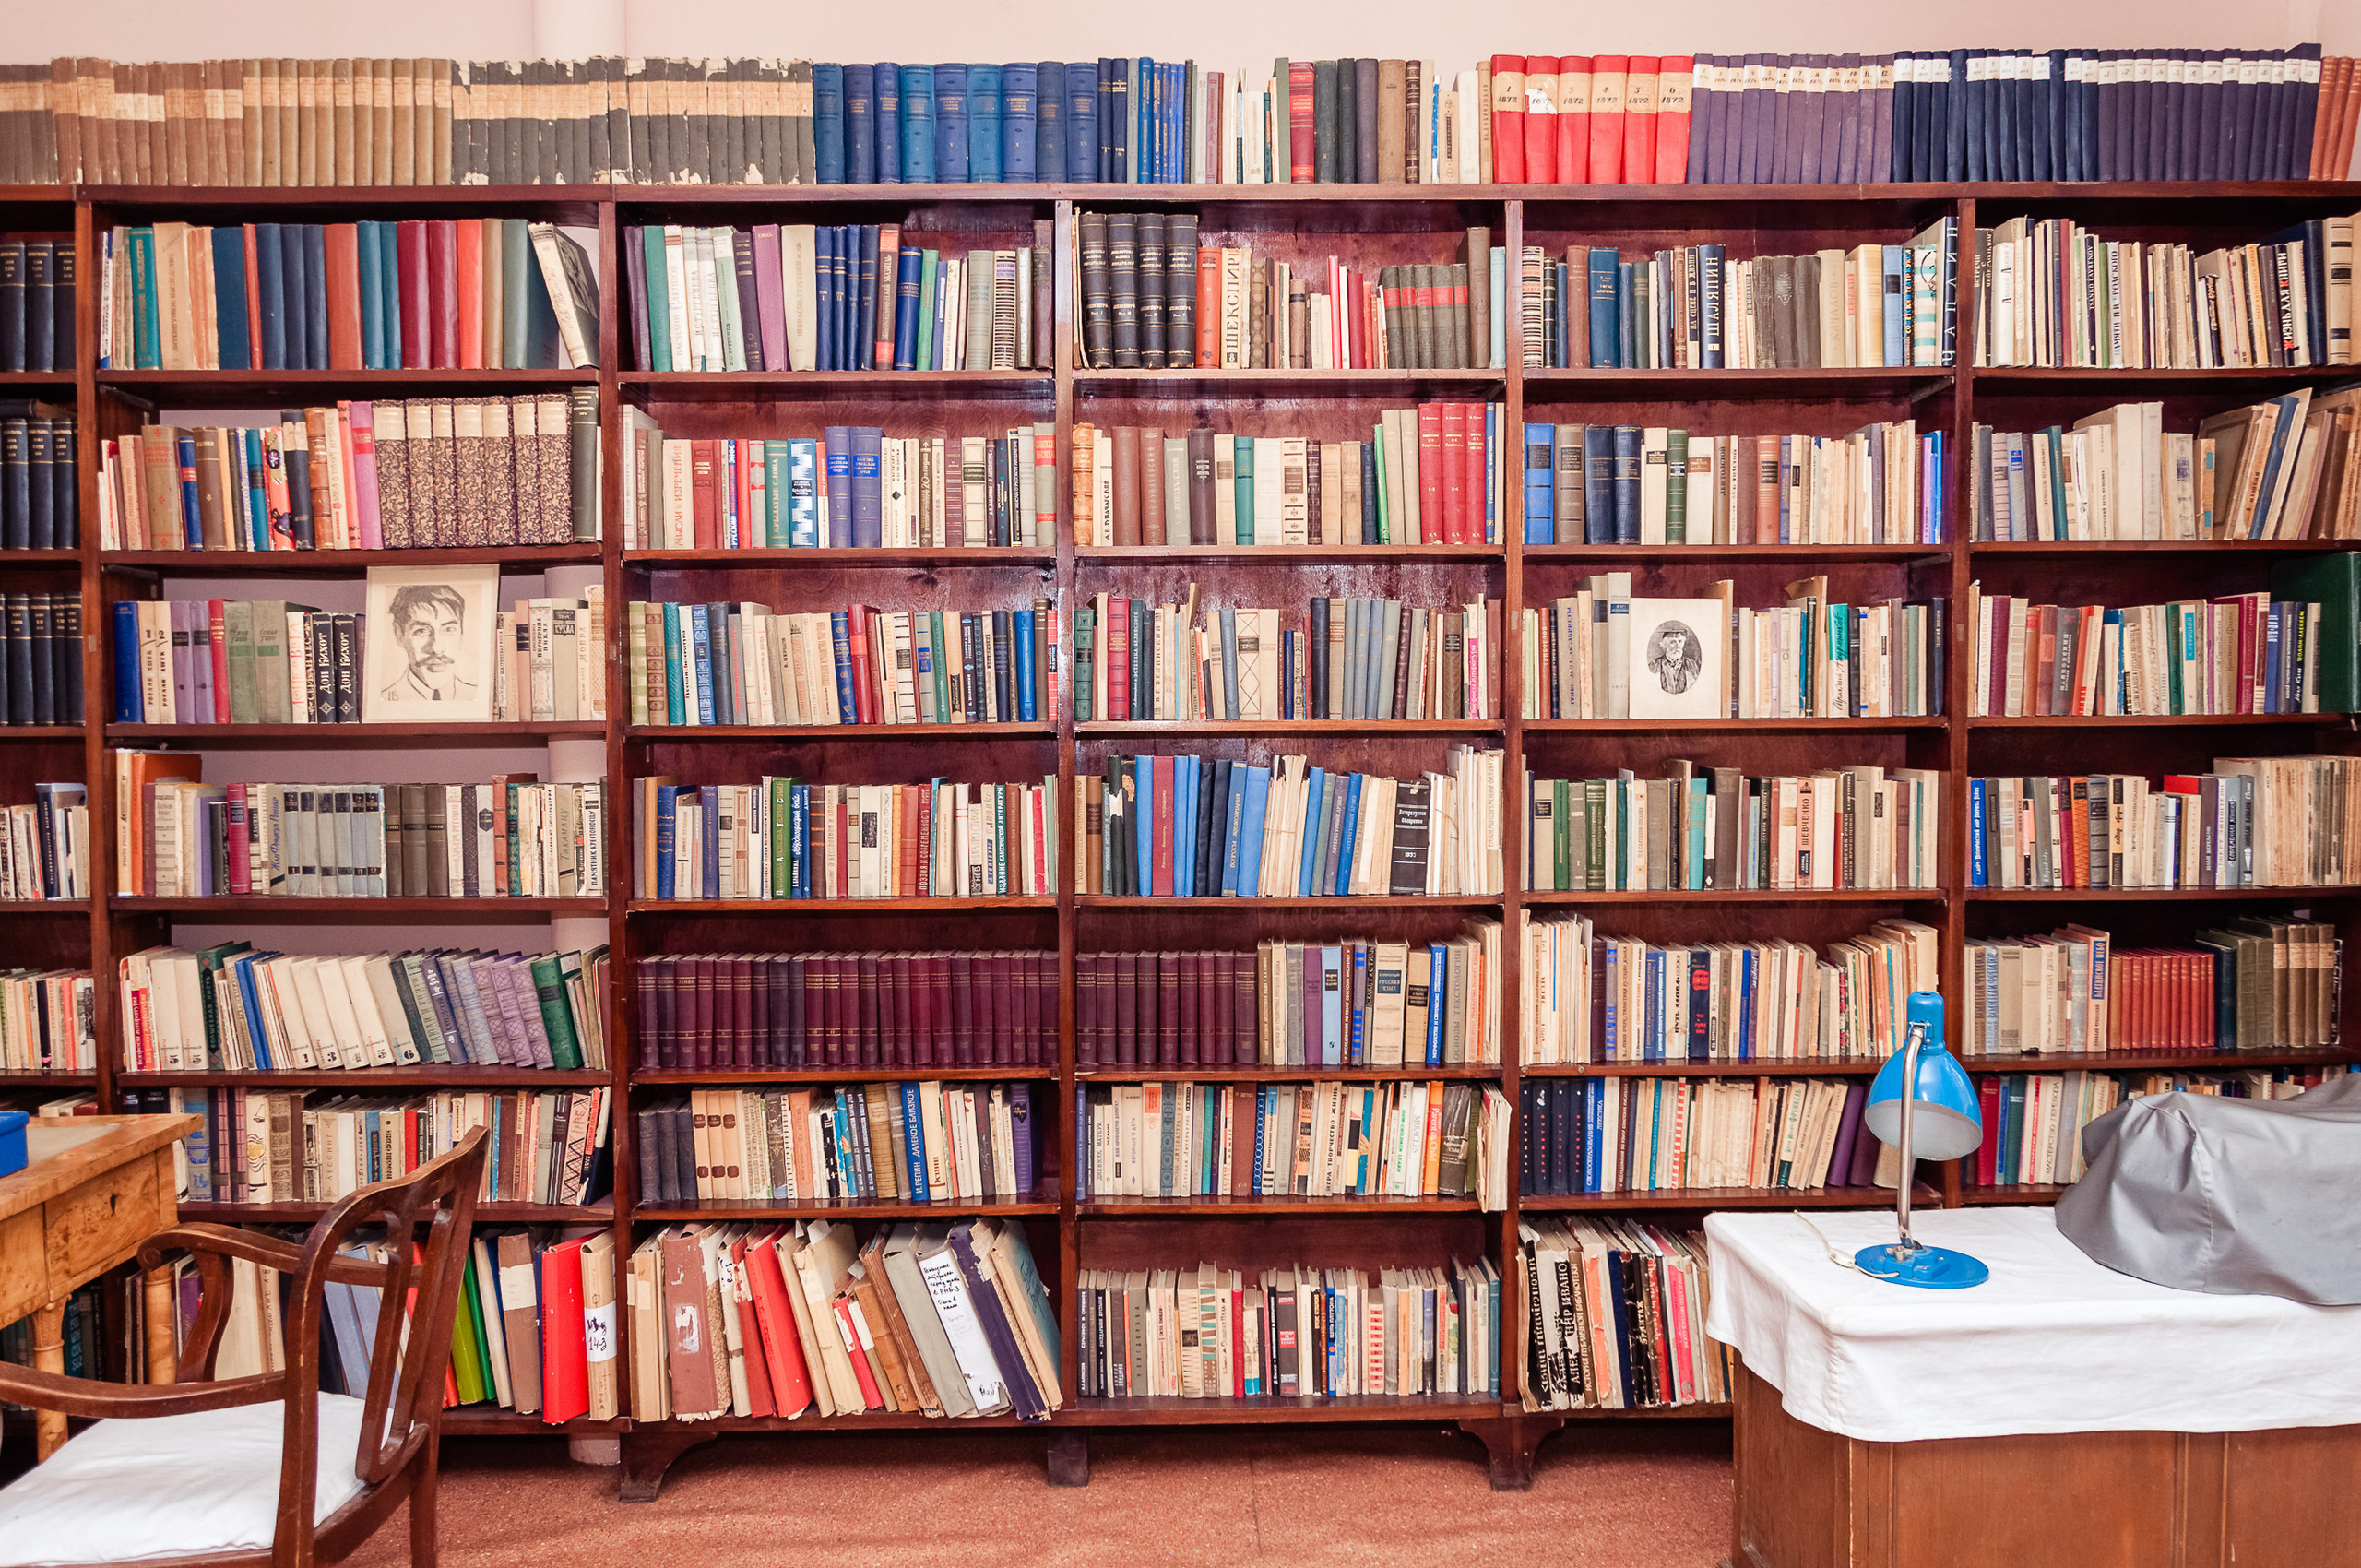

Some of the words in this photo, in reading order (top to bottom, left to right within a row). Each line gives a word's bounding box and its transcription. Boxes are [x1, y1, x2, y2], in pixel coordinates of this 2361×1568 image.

[1497, 95, 1518, 104] 1872
[1562, 96, 1584, 105] 1872
[1627, 96, 1650, 105] 1872
[1660, 95, 1685, 105] 1872
[1668, 86, 1677, 95] 6
[883, 255, 893, 282] УКАЗАТЕЛЬ
[1688, 255, 1696, 279] ЖИЗНИ
[2277, 252, 2289, 287] КНИГИ
[1225, 257, 1240, 349] ШЕКСПИР
[1689, 296, 1698, 317] СЦЕНЕ
[1704, 256, 1720, 337] ШАЛЯПИН
[1829, 280, 1840, 340] КАЧАЛОВ
[1941, 226, 1957, 362] ЧАПЛИН
[2087, 283, 2095, 310] TSANKO
[2280, 289, 2291, 312] ДЛЯ
[881, 283, 891, 340] БИБЛИОГРАФИЧЕСКИЙ
[1690, 320, 1697, 330] НА
[2280, 313, 2294, 351] ЖИЗНЬ
[727, 444, 736, 464] ЭПОС
[240, 457, 249, 487] НАРОДНАЯ
[242, 488, 251, 512] РУССКАЯ
[729, 515, 738, 546] РУССКИЙ
[974, 618, 983, 677] ШКЛОВСКИЙ
[1832, 612, 1847, 673] Андроников
[2296, 610, 2305, 661] ШОЛОМ-АЛЕЙХЕМ
[304, 637, 315, 701] СЕРВАНТЕС
[2059, 633, 2069, 691] МАЯКОВСКИЙ
[977, 678, 985, 718] ВИКТОР
[1832, 673, 1847, 710] Ираклий
[450, 803, 459, 832] РУГОНОВ
[1232, 793, 1240, 837] ЯЗЫКОЗНАНИЯ
[1335, 795, 1343, 814] АРХИВ
[2244, 802, 2252, 824] ВАВИЛОВ
[588, 810, 597, 849] КРЕСТОНОСЦУ
[920, 809, 930, 858] СОВРЕМЕННОСТЬ
[1332, 814, 1341, 855] ЛИТЕРАТУРНЫЙ
[1346, 813, 1355, 853] ЛИТЕРАТУРНЫЙ
[1800, 798, 1809, 846] ШЕВЧЕНКО
[2244, 825, 2252, 847] НИКОЛАЙ
[451, 833, 459, 861] КАРЬЕРА
[826, 824, 835, 861] БЕССПОРНОМ
[997, 825, 1005, 861] КЛАССИЧЕСКОЙ
[919, 865, 928, 890] ПОЭЗИЯ
[973, 865, 981, 891] ОГНЕВ
[997, 862, 1006, 893] ИЗДАНИЕ
[2094, 942, 2105, 959] НЕБО
[1453, 950, 1462, 1016] ТЕКСТОЛОГИИ
[1975, 952, 1984, 984] ФРЕГАТОВ
[1987, 952, 1998, 984] ФРЕГАТОВ
[2093, 960, 2105, 998] БАЛТИЙСКОЕ
[411, 977, 427, 1005] КНИГИ
[1975, 985, 1985, 1019] ВОДИТЕЛИ
[1987, 984, 1999, 1018] ВОДИТЕЛИ
[132, 996, 142, 1036] литературы
[140, 994, 150, 1034] литературы
[207, 1004, 216, 1049] ВОЛШЕБНАЯ
[422, 1016, 442, 1042] ЛЮДИ
[143, 1033, 151, 1063] Вопросы
[906, 1089, 917, 1123] БЛИЗКОЕ
[1788, 1088, 1802, 1123] ФРЕНКЕЛЬ
[2049, 1082, 2059, 1122] ПЕРЕВОДА
[909, 1124, 920, 1158] ДАЛЕКОЕ
[1327, 1120, 1335, 1167] ТВОРЧЕСТВО
[1412, 1115, 1421, 1154] MIRACLES
[2045, 1124, 2056, 1174] МАСТЕРСТВО
[913, 1161, 923, 1194] И.РЕПИН
[1645, 1258, 1657, 1271] The
[1571, 1263, 1584, 1312] БИБЛИОТЕКИ
[1646, 1271, 1657, 1298] Arts
[1677, 1272, 1685, 1306] ANNOTATED
[1649, 1300, 1657, 1309] in
[1577, 1312, 1588, 1357] ПУБЛИЧНОЙ
[1636, 1301, 1647, 1345] ЭРМИТАЖ
[1651, 1311, 1662, 1341] Canada
[1582, 1357, 1592, 1392] ИСТОРИЯ
